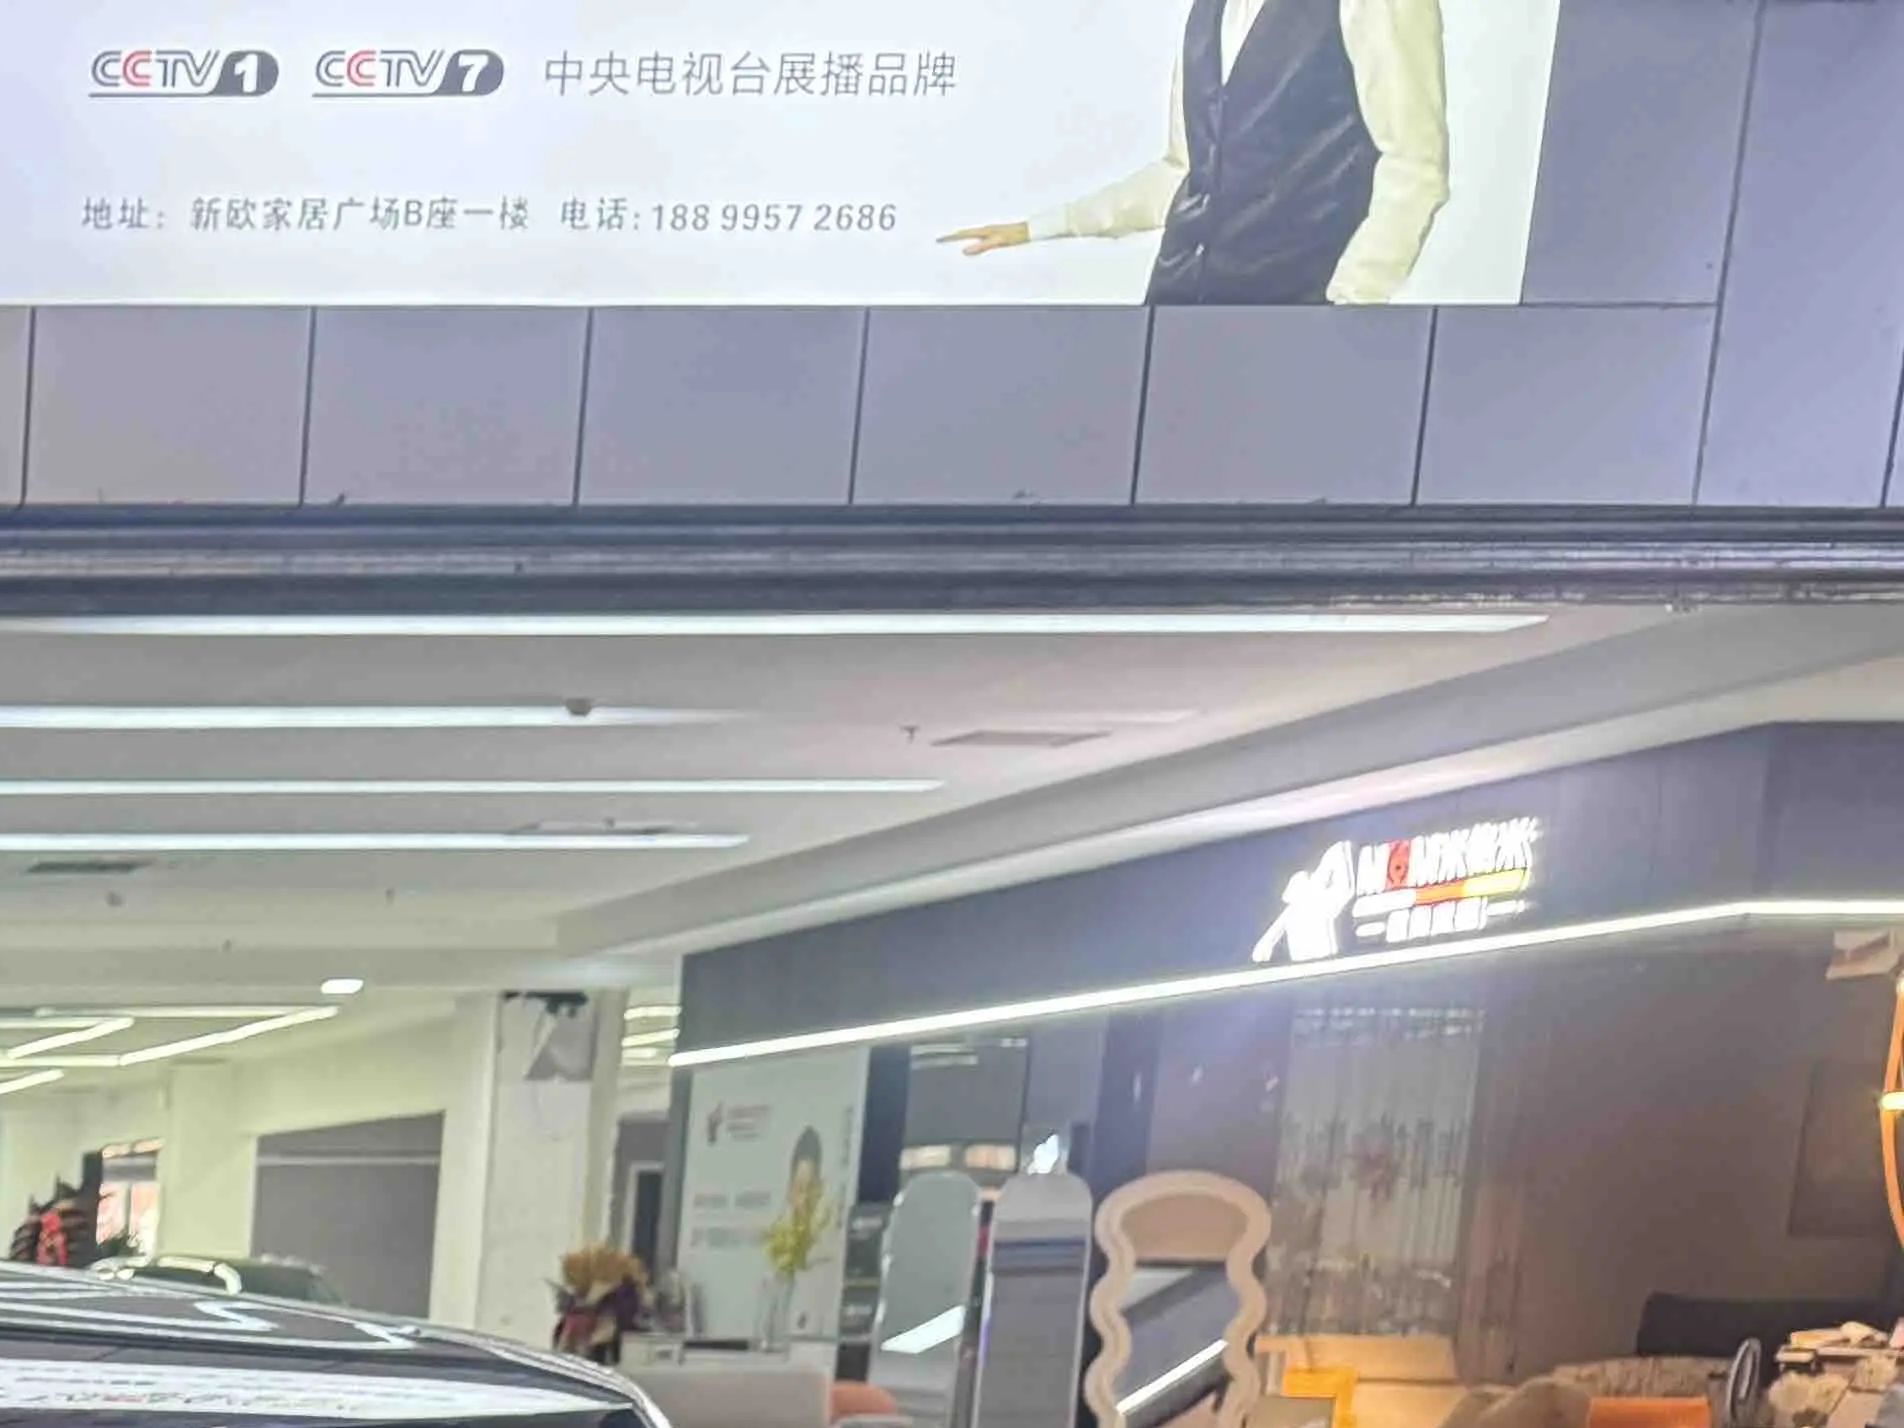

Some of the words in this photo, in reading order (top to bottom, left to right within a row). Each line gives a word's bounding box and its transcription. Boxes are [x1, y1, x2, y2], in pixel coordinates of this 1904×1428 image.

[544, 50, 960, 97] 中央电视台展播品牌
